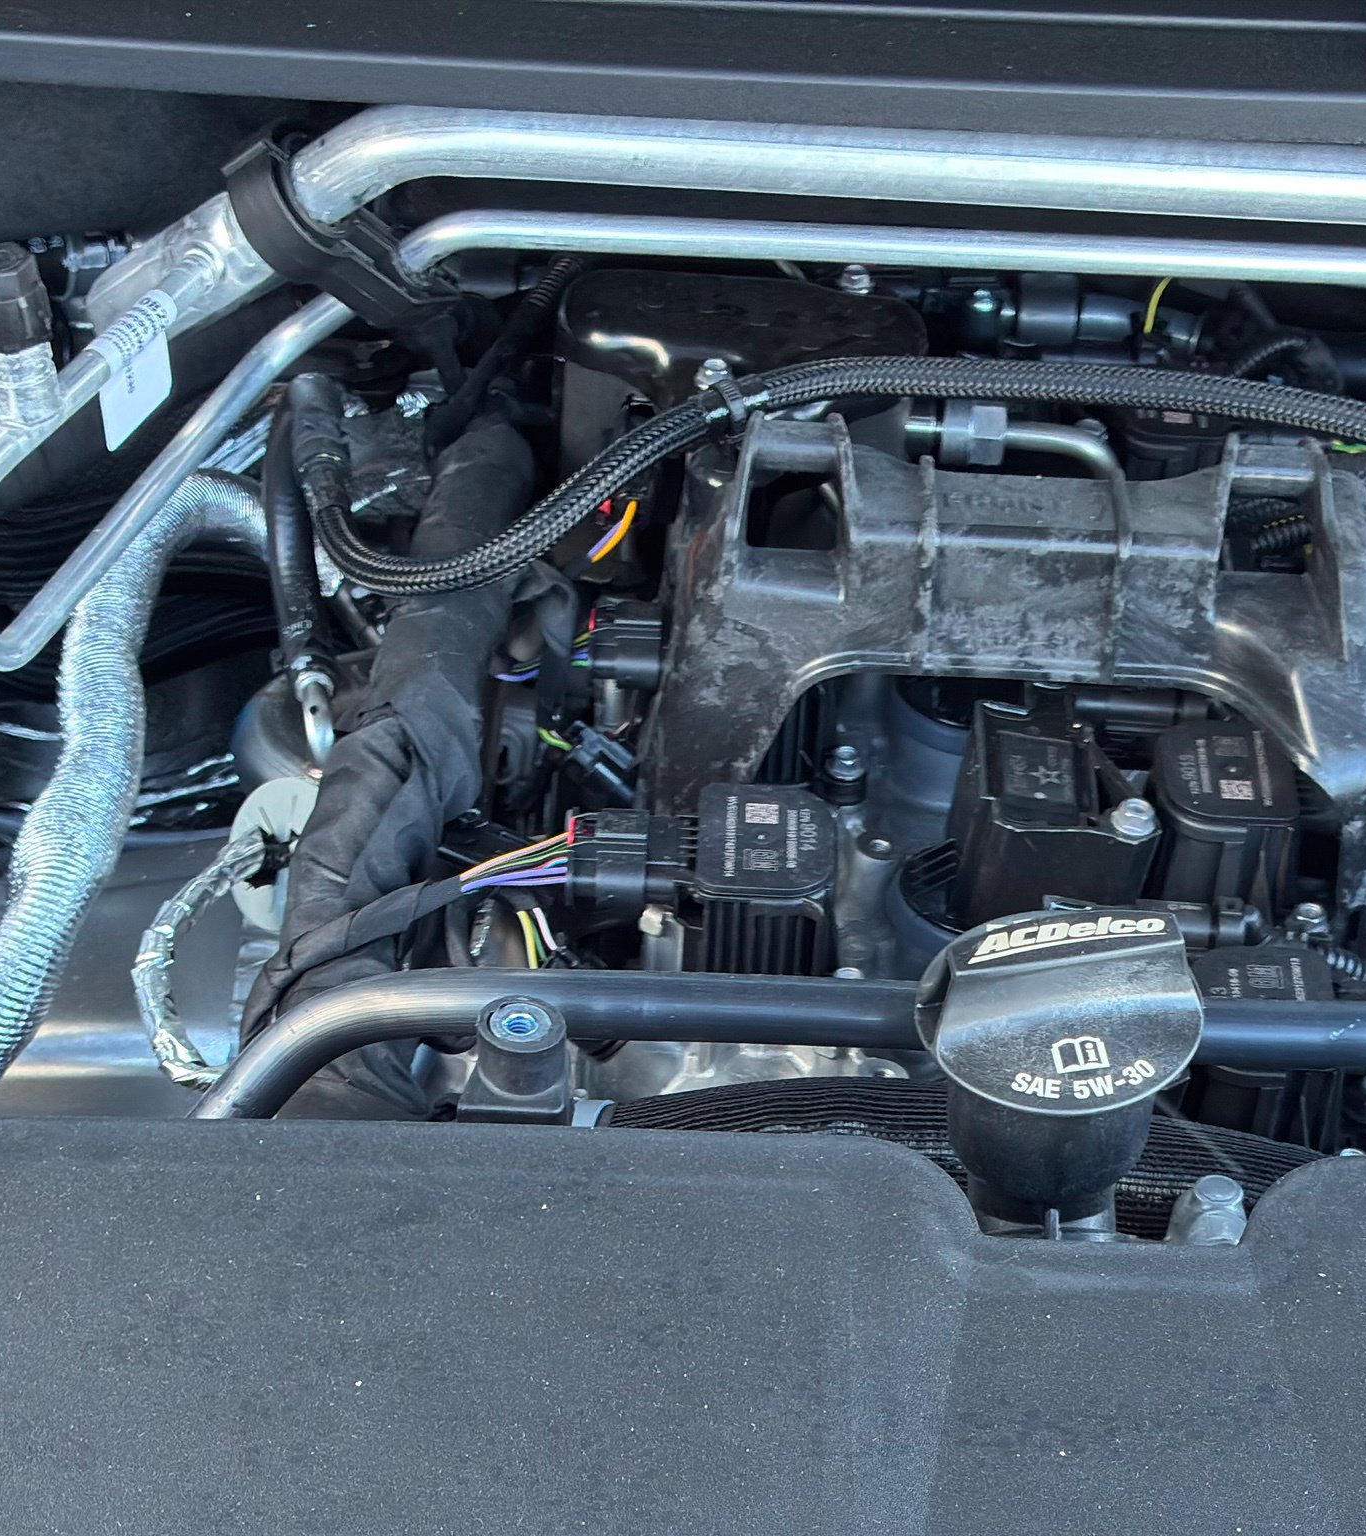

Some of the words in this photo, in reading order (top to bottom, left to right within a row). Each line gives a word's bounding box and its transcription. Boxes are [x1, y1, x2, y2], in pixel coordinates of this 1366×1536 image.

[974, 916, 1166, 956] ACDelco
[1011, 1072, 1061, 1099] SAE
[1072, 1059, 1156, 1100] 5W-30
